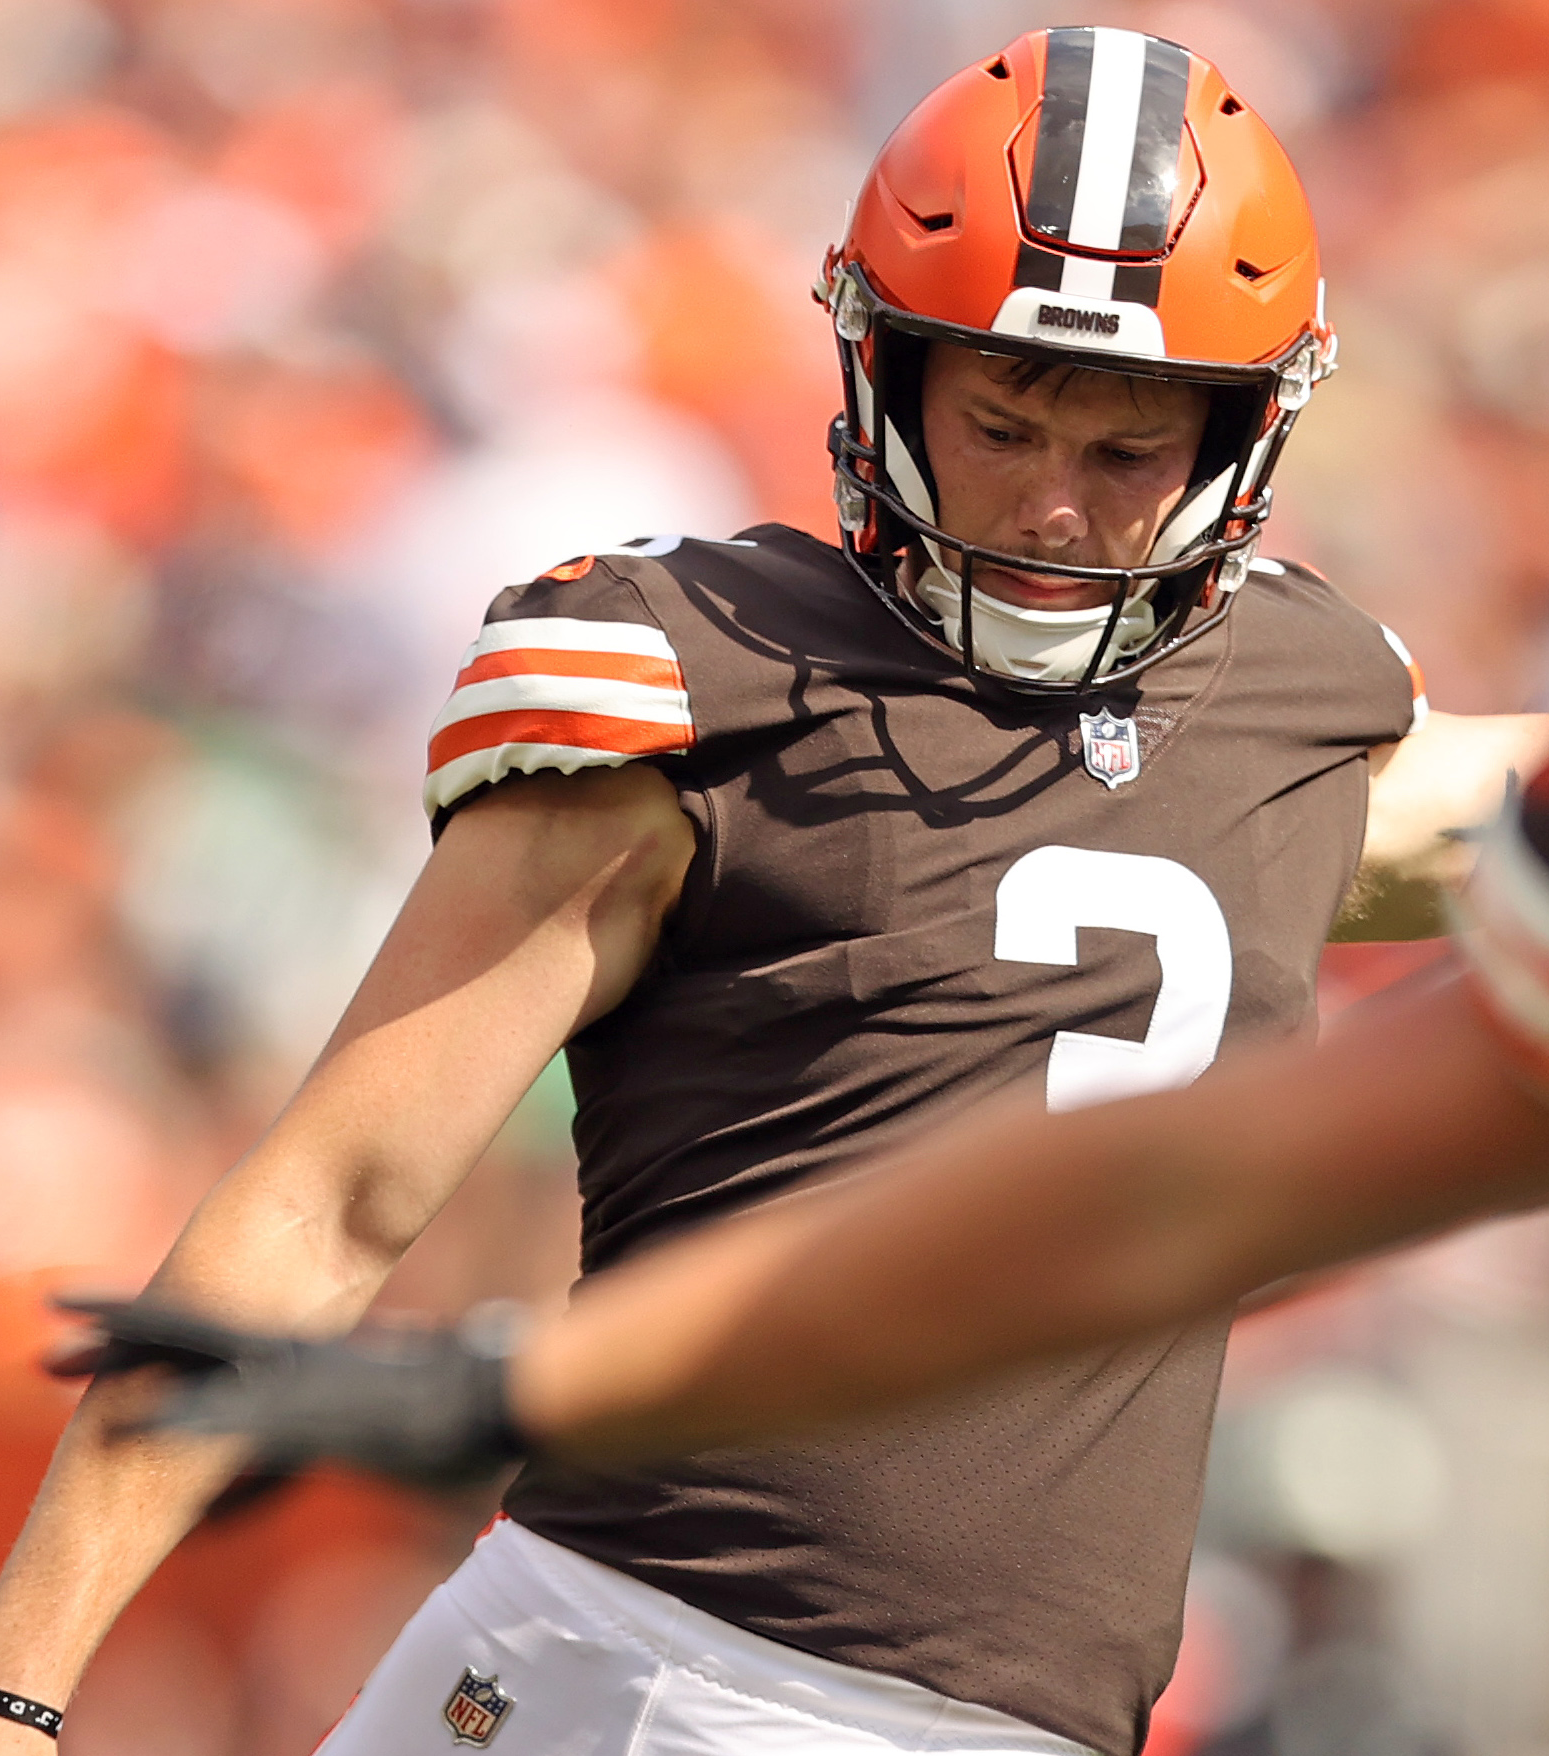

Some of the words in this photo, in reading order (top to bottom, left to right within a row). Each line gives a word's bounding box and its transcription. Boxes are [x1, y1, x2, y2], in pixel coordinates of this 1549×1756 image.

[1036, 304, 1121, 335] BROWNS
[1090, 740, 1132, 773] NFL
[449, 1695, 489, 1738] NFL
